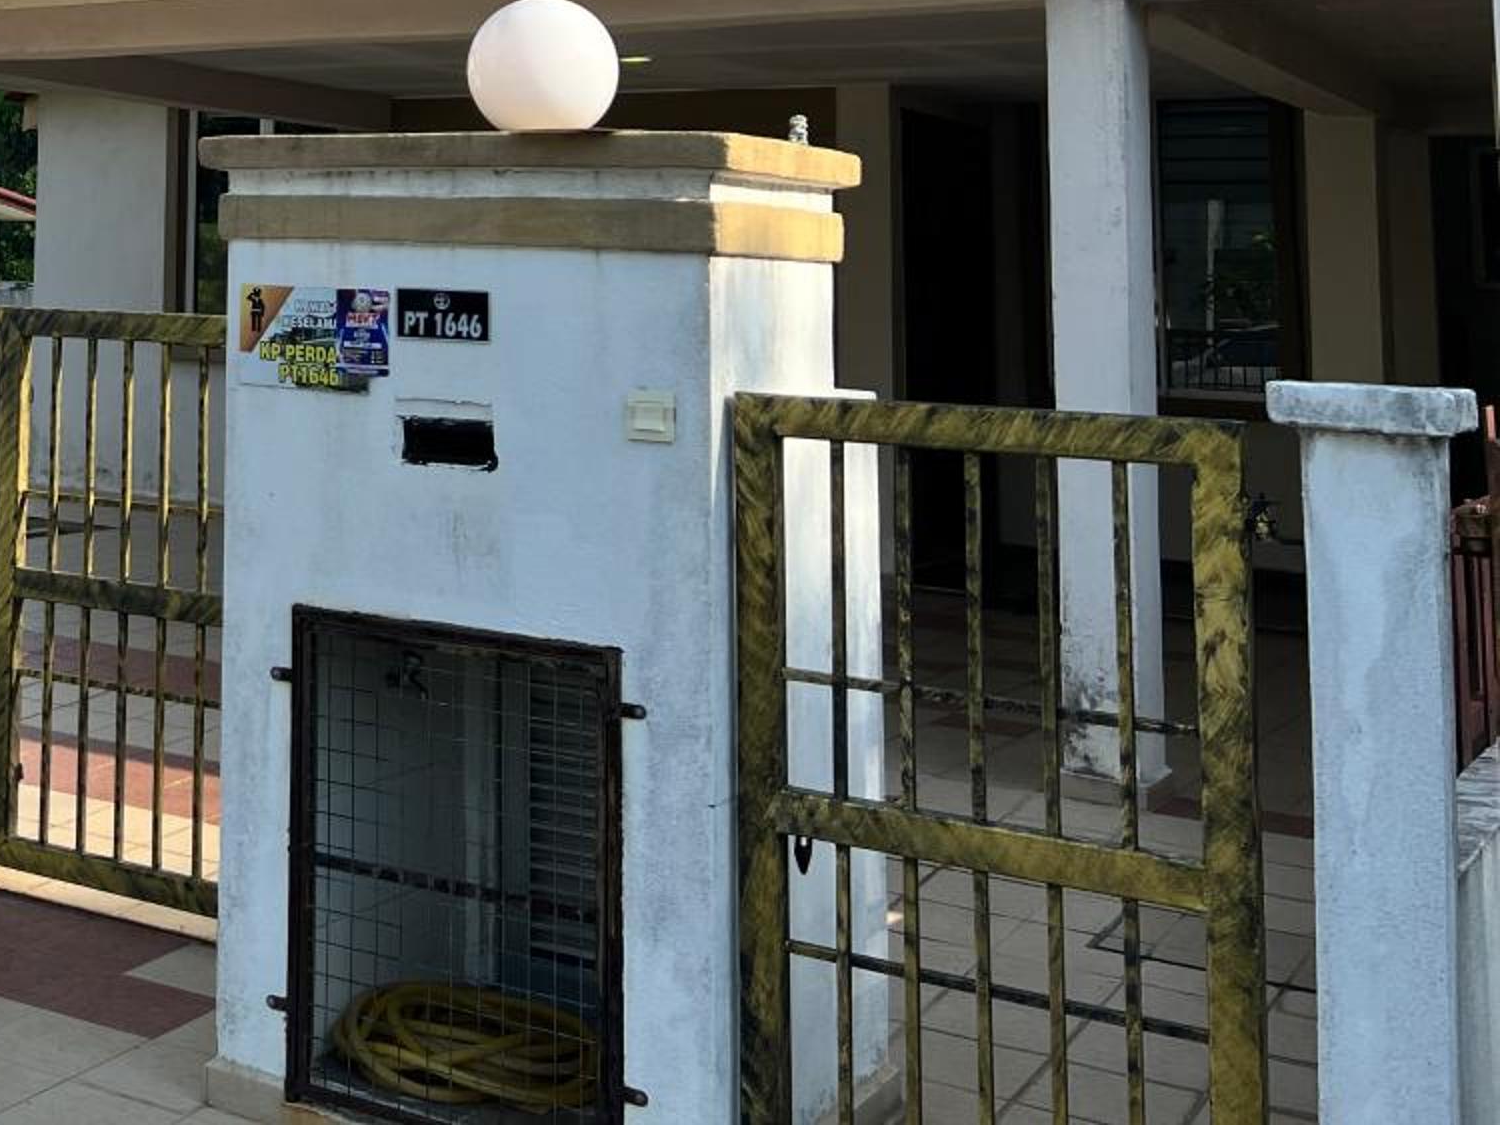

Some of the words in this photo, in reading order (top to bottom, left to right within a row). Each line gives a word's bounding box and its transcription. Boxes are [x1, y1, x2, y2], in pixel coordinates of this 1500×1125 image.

[404, 311, 428, 335] PT
[434, 312, 482, 338] 1646
[260, 341, 280, 361] KP
